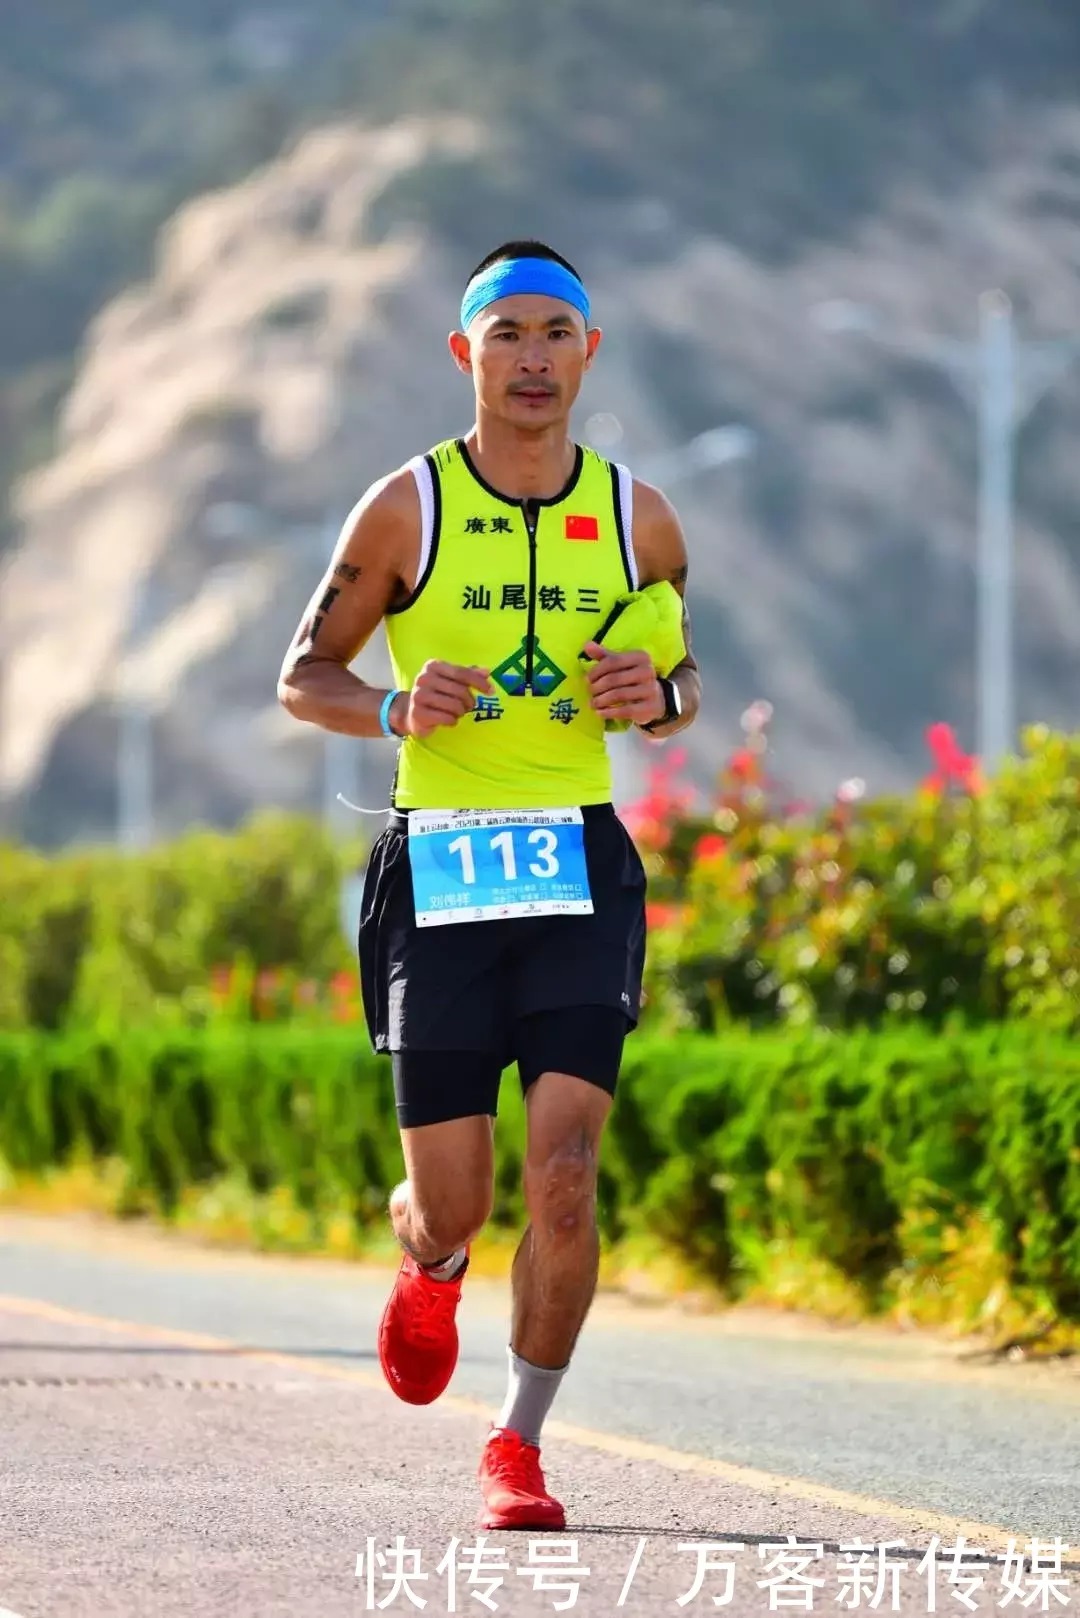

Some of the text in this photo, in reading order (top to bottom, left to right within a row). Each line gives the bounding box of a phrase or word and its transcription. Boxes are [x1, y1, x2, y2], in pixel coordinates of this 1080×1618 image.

[464, 517, 513, 534] 廣東
[462, 584, 600, 613] 汕尾铁三
[447, 828, 560, 885] 113
